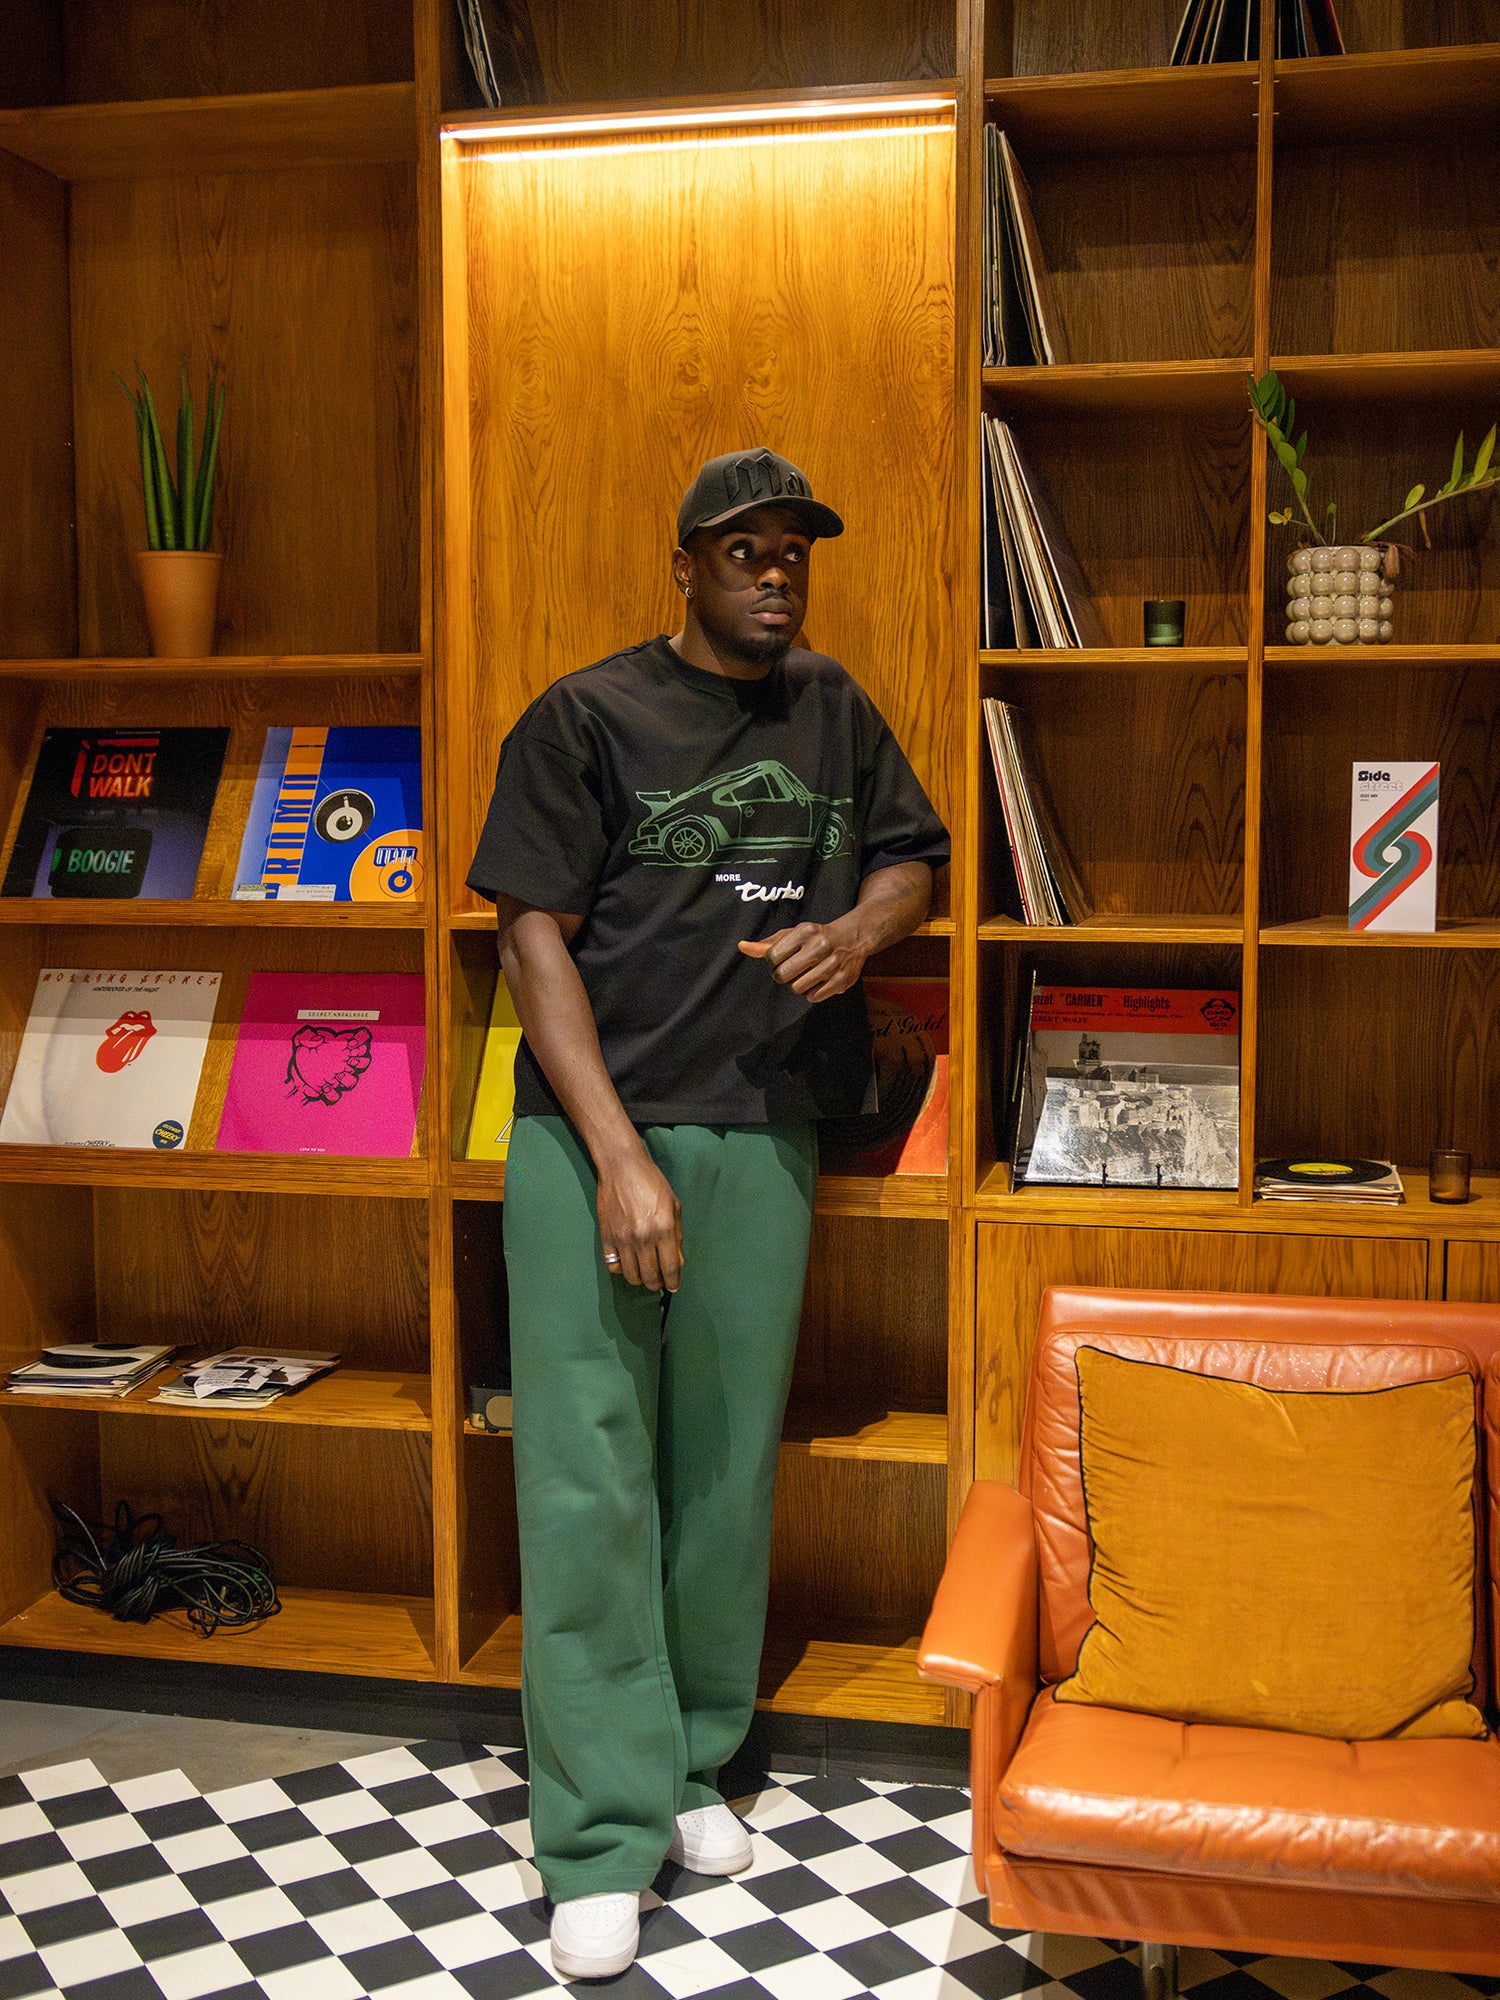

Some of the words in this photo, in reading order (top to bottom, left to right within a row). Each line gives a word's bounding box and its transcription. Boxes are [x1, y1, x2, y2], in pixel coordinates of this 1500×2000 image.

[1358, 770, 1391, 782] Side
[89, 776, 154, 798] WALK
[67, 848, 135, 874] BOOGIE
[715, 873, 741, 882] MORE
[735, 879, 805, 902] turbo
[1123, 995, 1170, 1012] Highlights
